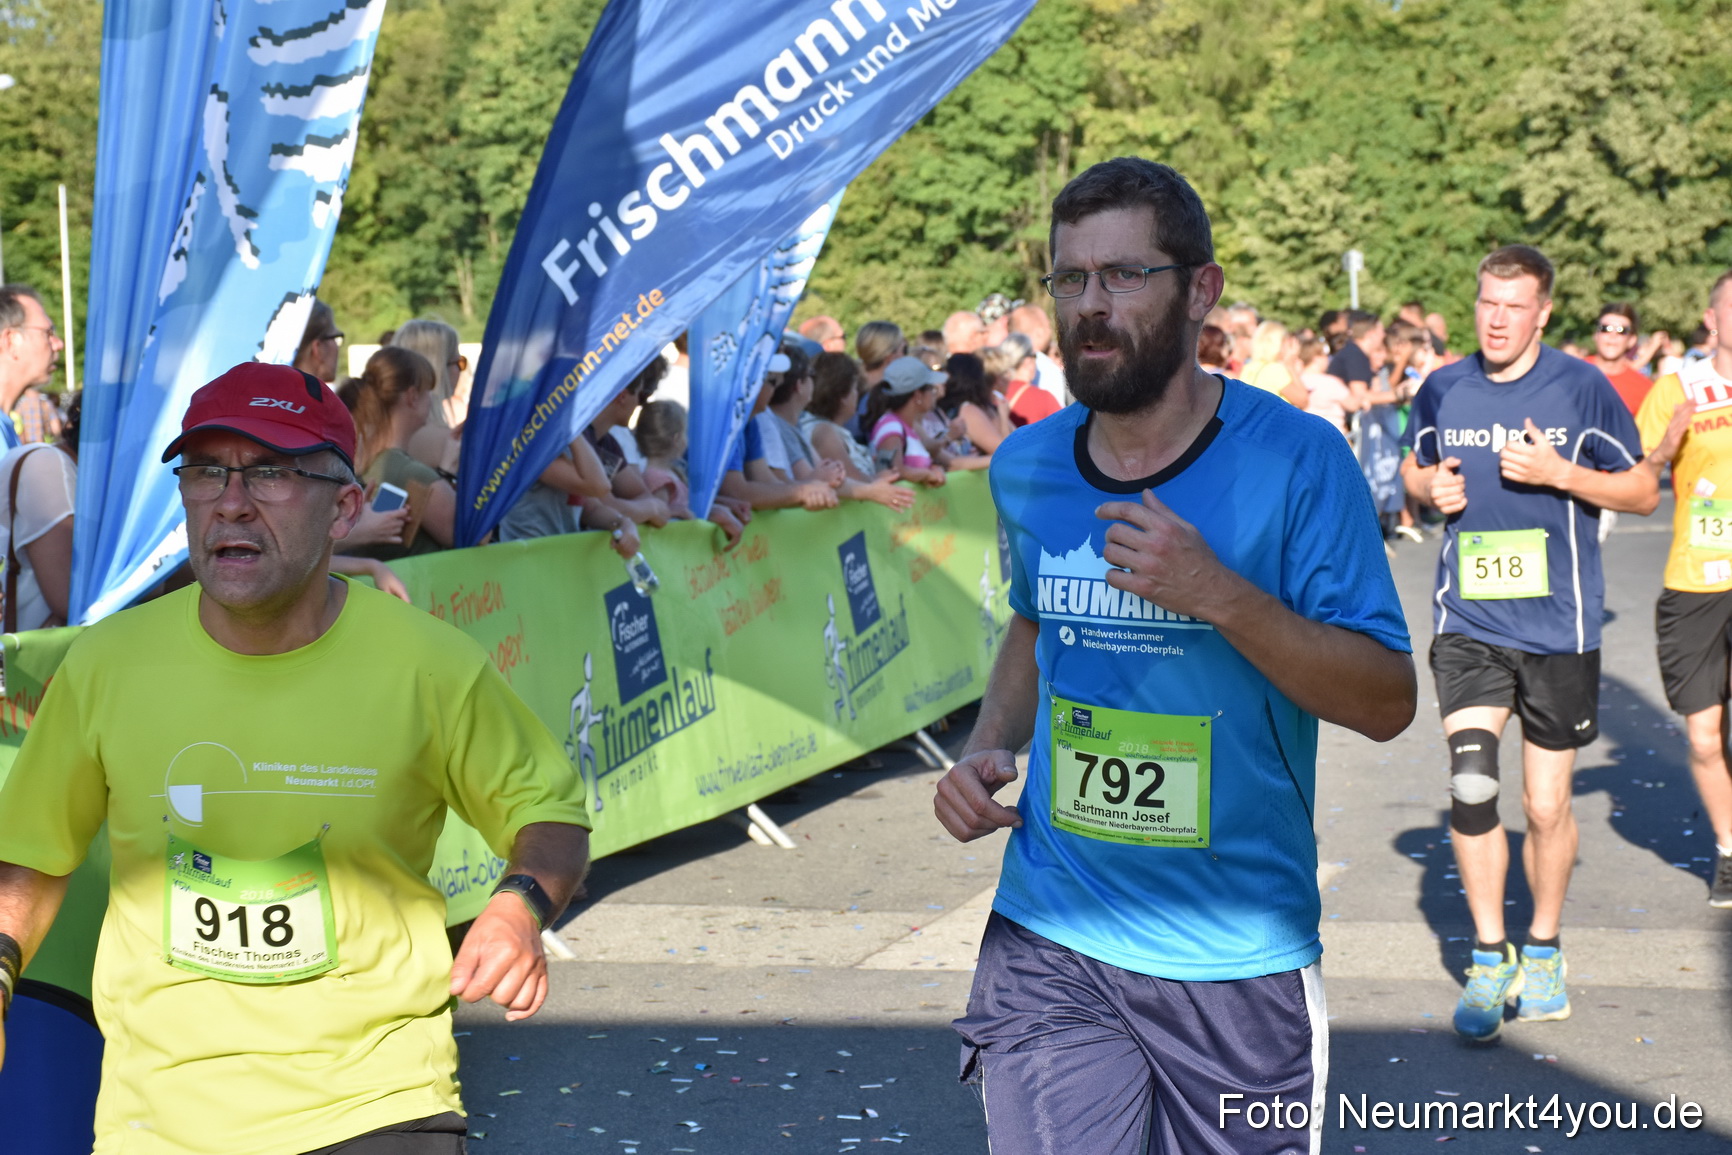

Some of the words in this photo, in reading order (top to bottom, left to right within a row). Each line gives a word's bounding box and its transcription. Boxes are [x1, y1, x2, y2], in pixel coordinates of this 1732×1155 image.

[766, 80, 854, 161] Druck
[851, 21, 911, 84] und
[906, 0, 958, 32] Me
[541, 0, 887, 306] Frischmann
[248, 397, 306, 414] 2XU
[1694, 413, 1732, 435] MA
[1444, 428, 1491, 447] EURO
[1475, 556, 1523, 579] 518
[1080, 627, 1165, 642] Handwerkskammer
[1082, 639, 1184, 657] Niederbayern-Oberpfalz
[602, 647, 716, 773] firmenlauf
[1065, 721, 1112, 740] firmenlauf
[1118, 742, 1149, 754] 2018
[253, 762, 296, 772] Kliniken
[300, 763, 318, 773] des
[320, 765, 378, 776] Landkreises
[609, 751, 659, 800] neumarkt
[1075, 752, 1165, 808] 792
[285, 775, 338, 787] Neumarkt
[1057, 807, 1107, 827] Handwerkskammer
[1108, 820, 1197, 834] Niederbayern-Oberpfalz
[1073, 800, 1128, 820] Bartmann
[1132, 811, 1170, 823] Josef
[183, 862, 232, 889] firmenlauf
[239, 889, 275, 900] 2018
[195, 897, 293, 948] 918
[193, 941, 238, 960] Fischer
[245, 949, 301, 962] Thomas
